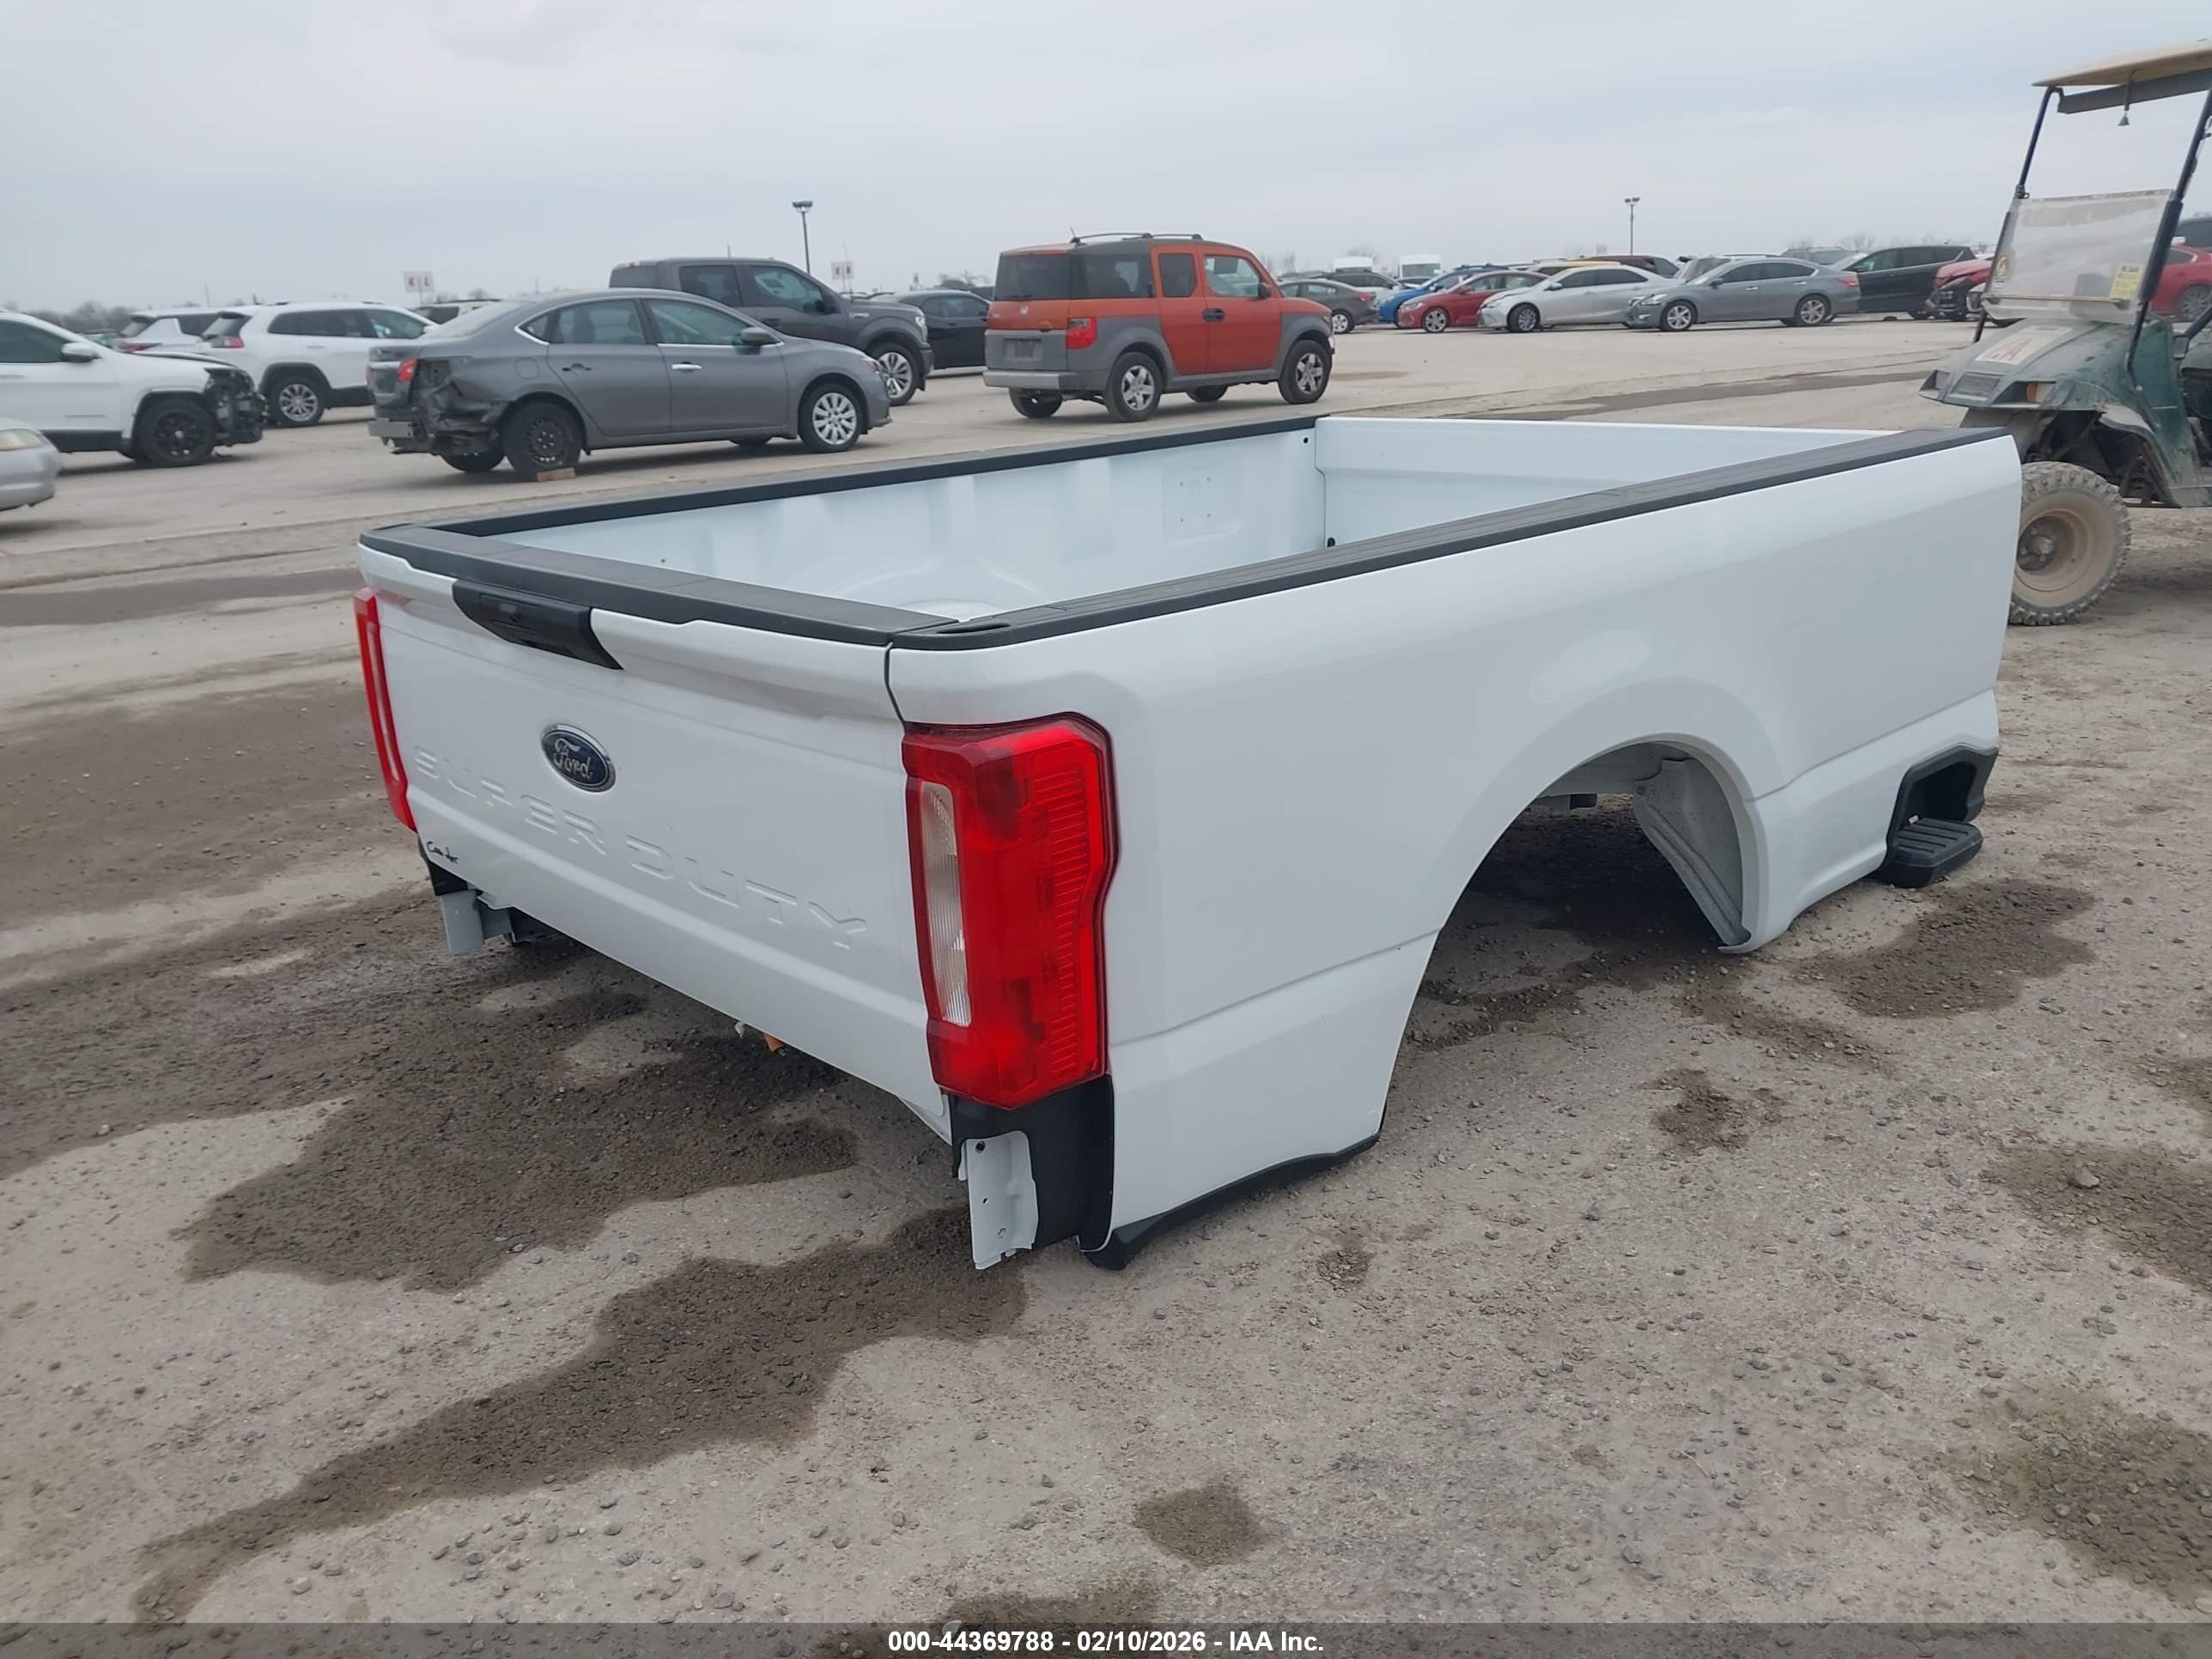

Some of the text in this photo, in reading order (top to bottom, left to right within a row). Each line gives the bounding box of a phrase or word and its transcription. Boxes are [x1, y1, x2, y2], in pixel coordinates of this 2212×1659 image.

[553, 738, 593, 780] Ford
[413, 745, 866, 951] SUPER DUTY
